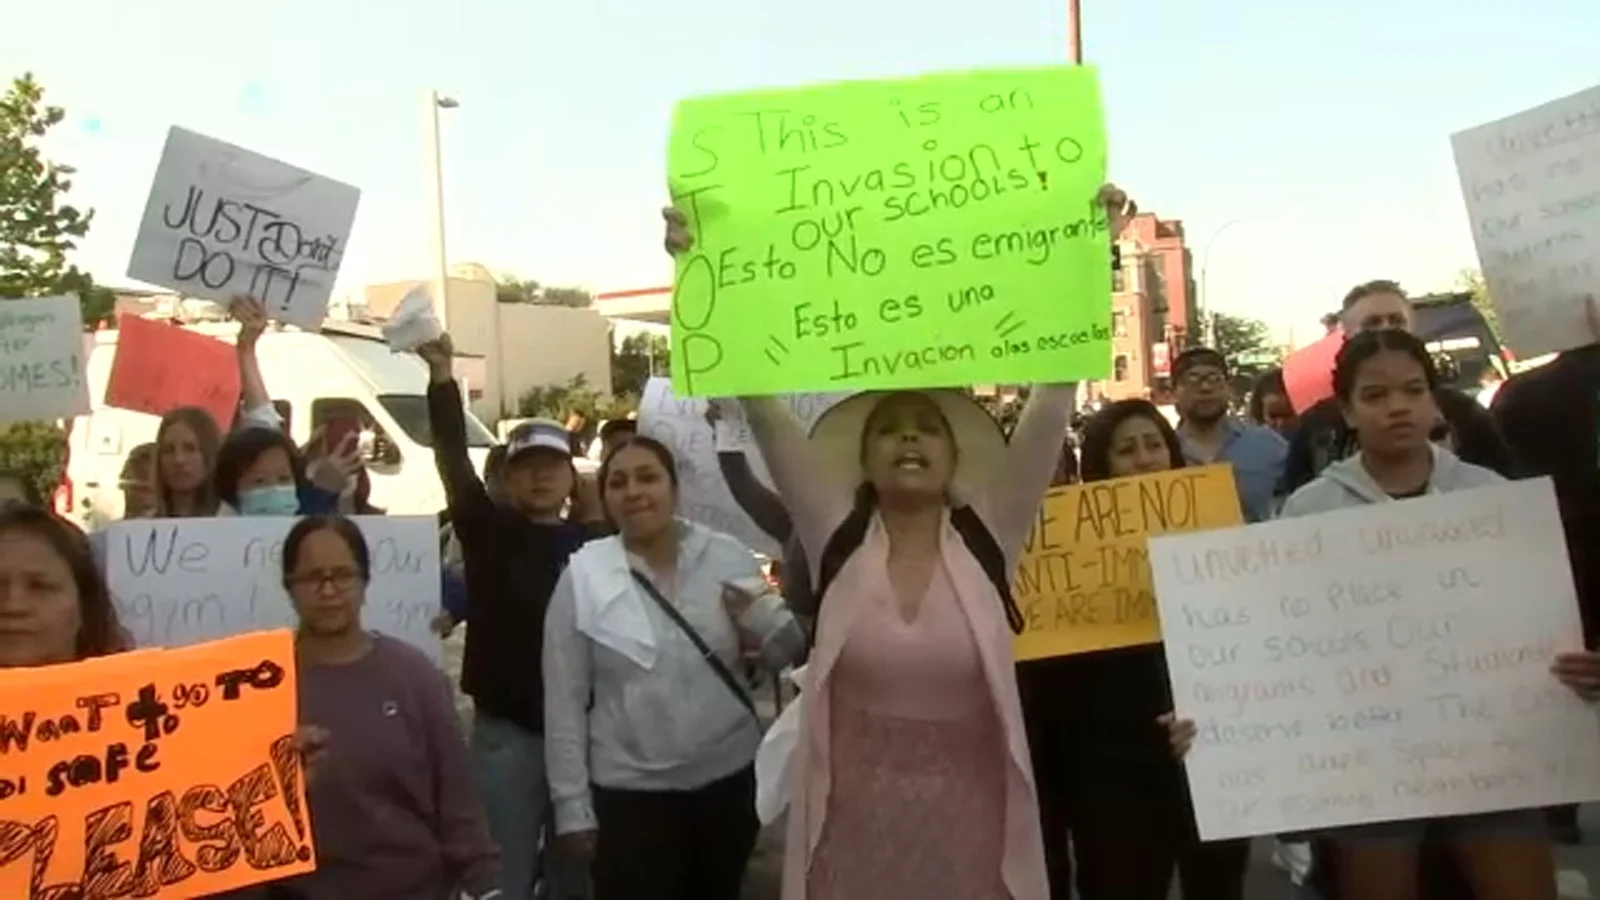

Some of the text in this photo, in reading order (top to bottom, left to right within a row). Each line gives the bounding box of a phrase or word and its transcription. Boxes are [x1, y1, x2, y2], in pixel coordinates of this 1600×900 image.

[731, 87, 1034, 156] This is an
[775, 133, 1084, 215] Invasion to
[163, 184, 281, 252] JUST
[792, 204, 867, 251] our
[172, 237, 300, 312] DO IT!
[718, 246, 797, 290] Esto
[825, 235, 887, 280] No
[911, 237, 958, 269] es
[794, 282, 996, 339] Esto es una
[829, 341, 976, 382] Invacion
[1074, 481, 1138, 543] ARE
[1138, 474, 1209, 531] NOT
[125, 524, 211, 577] We
[372, 535, 428, 576] Our
[1182, 603, 1252, 632] has
[171, 683, 210, 708] go
